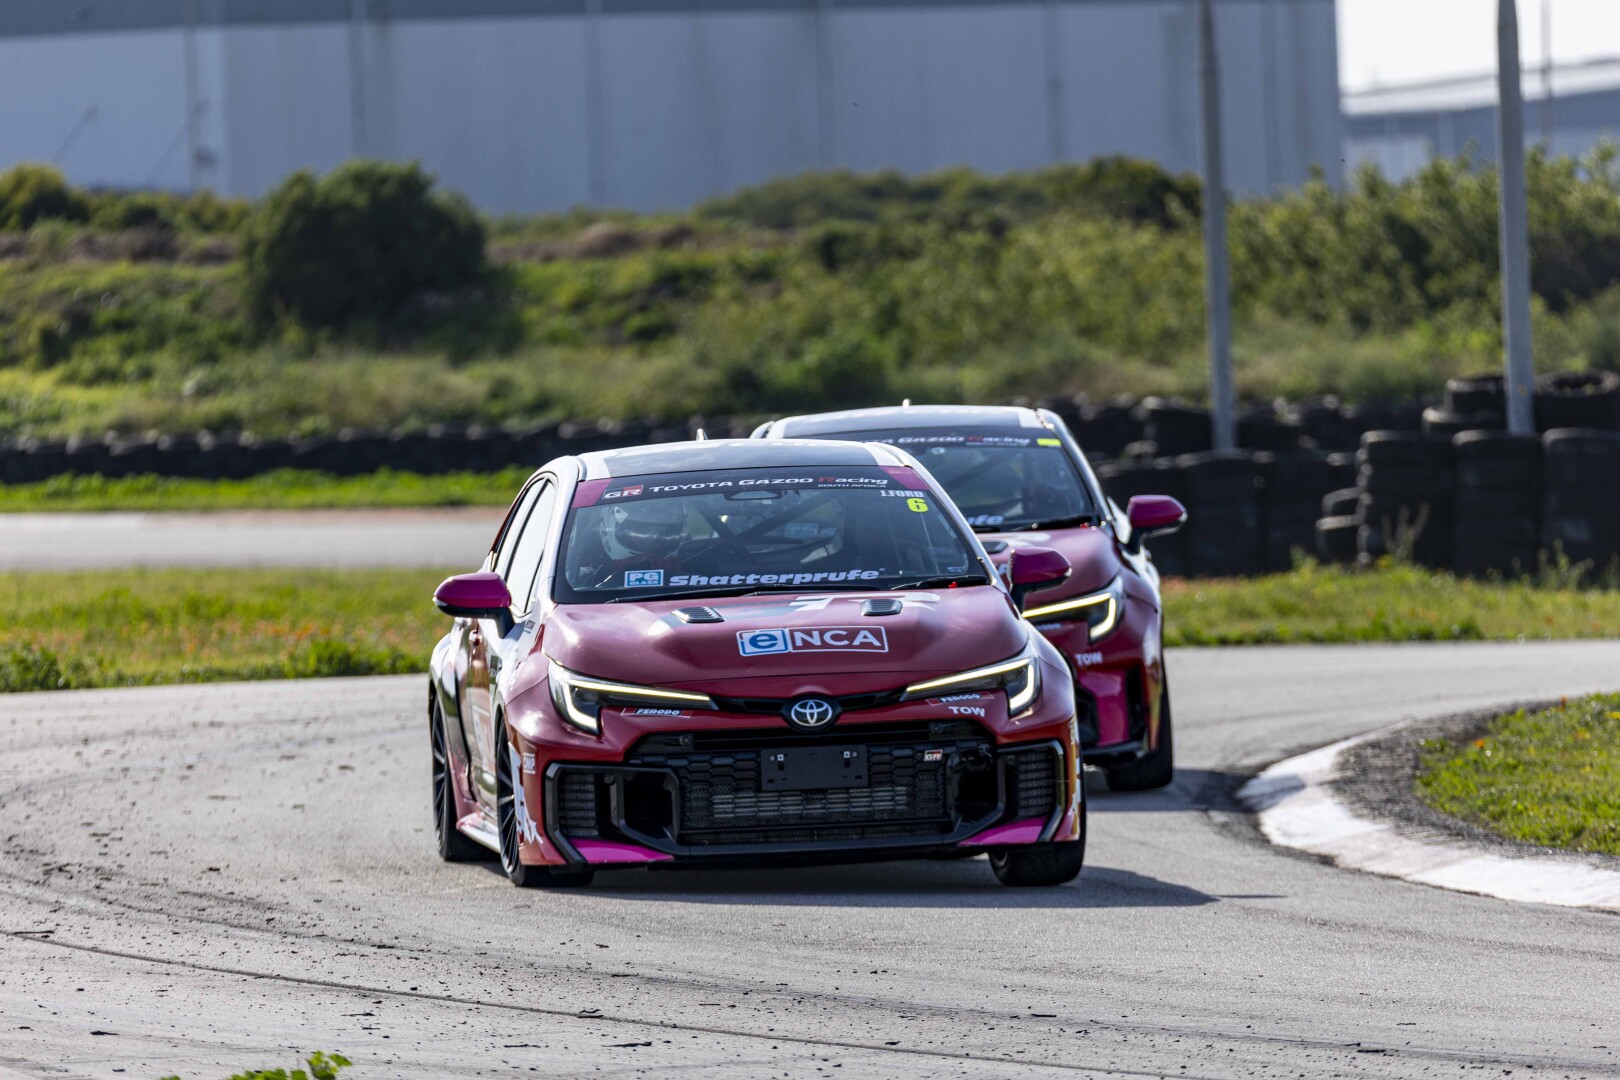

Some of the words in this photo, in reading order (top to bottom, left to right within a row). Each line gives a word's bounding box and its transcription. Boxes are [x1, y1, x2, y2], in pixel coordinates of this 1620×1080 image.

[604, 489, 641, 499] GR
[649, 481, 733, 492] TOYOTA
[738, 477, 813, 486] GAZOO
[818, 476, 888, 485] Racing
[880, 490, 924, 498] J.FORD
[906, 498, 928, 513] 6
[629, 572, 659, 581] PG
[669, 569, 880, 586] Shatterprufe
[1075, 651, 1103, 666] TOW
[948, 706, 986, 717] TOW
